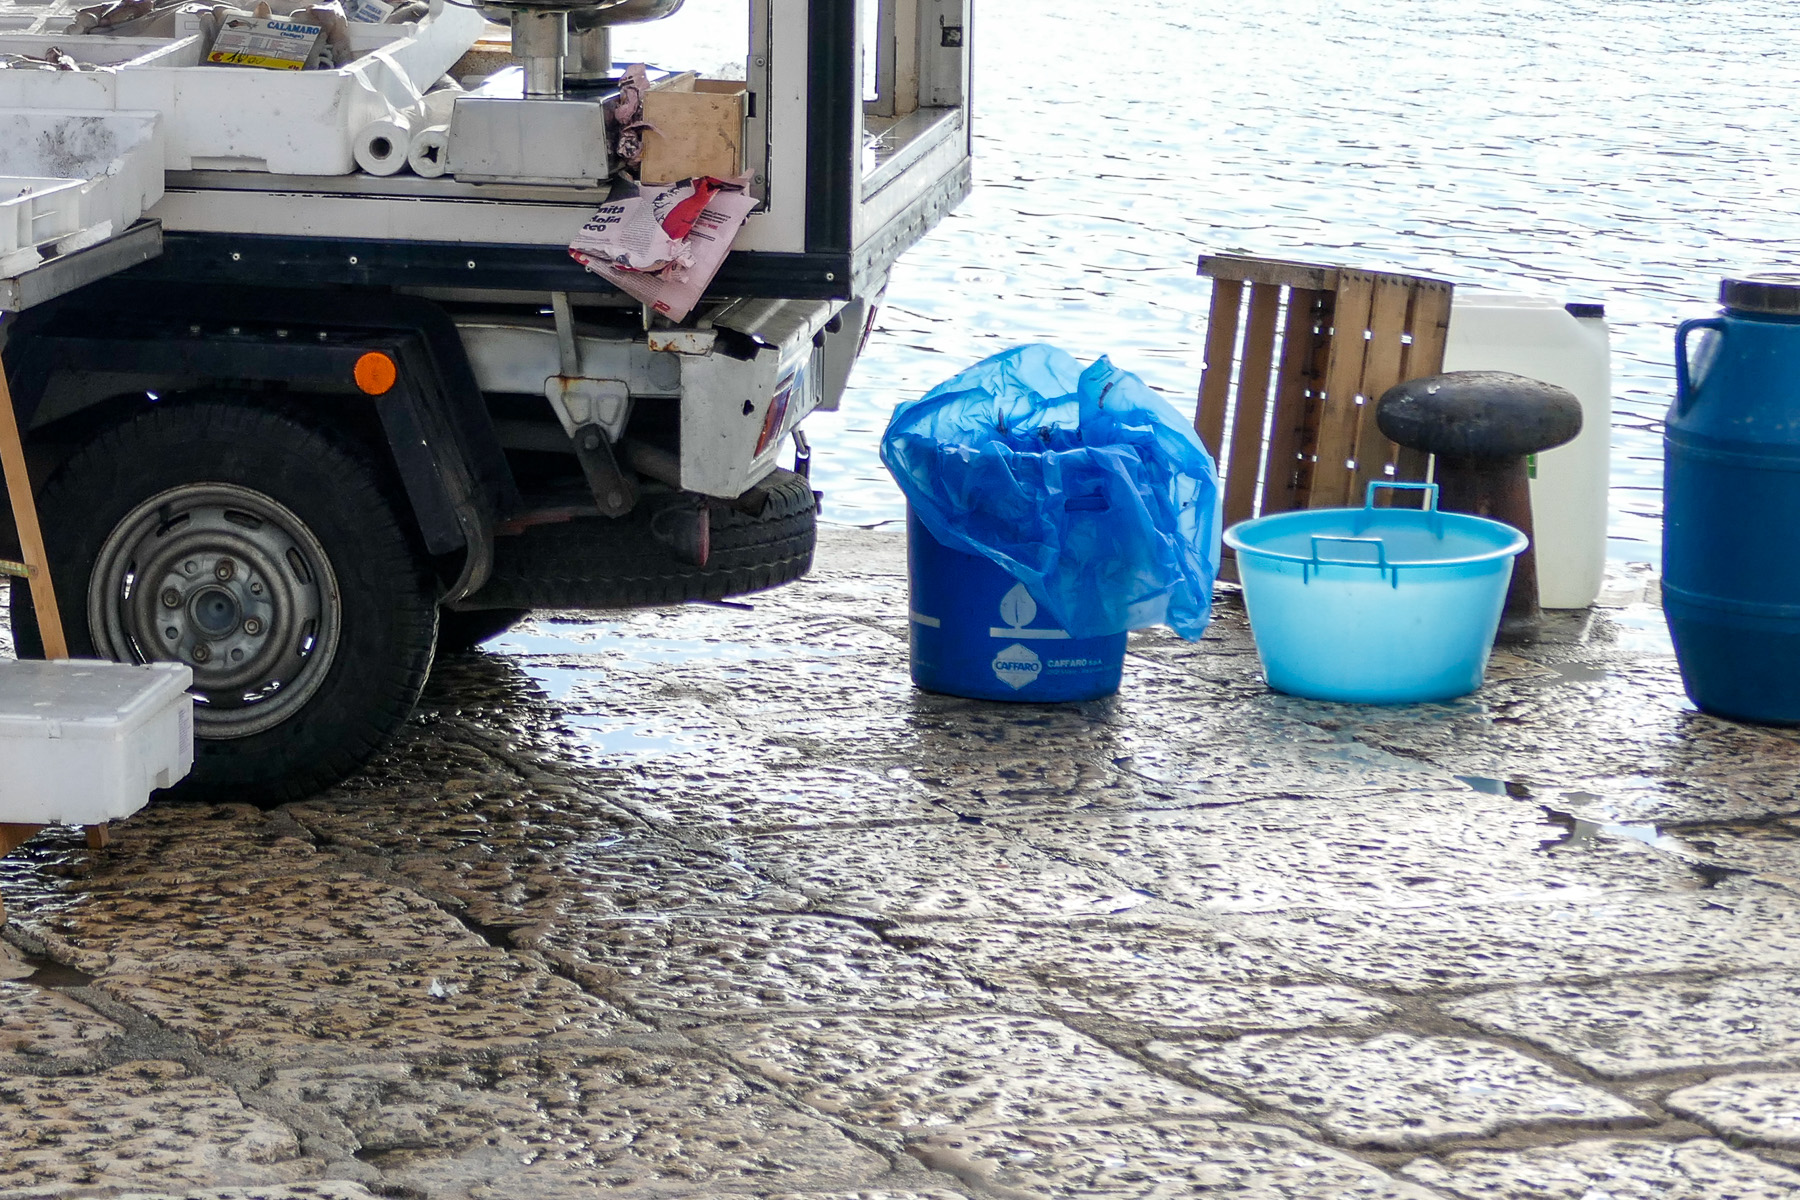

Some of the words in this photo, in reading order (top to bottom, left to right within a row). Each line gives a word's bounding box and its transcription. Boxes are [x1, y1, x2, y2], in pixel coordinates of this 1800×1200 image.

[267, 21, 320, 36] CALAMARO
[996, 661, 1039, 672] CAFFARO
[1047, 659, 1087, 669] CAFFARO
